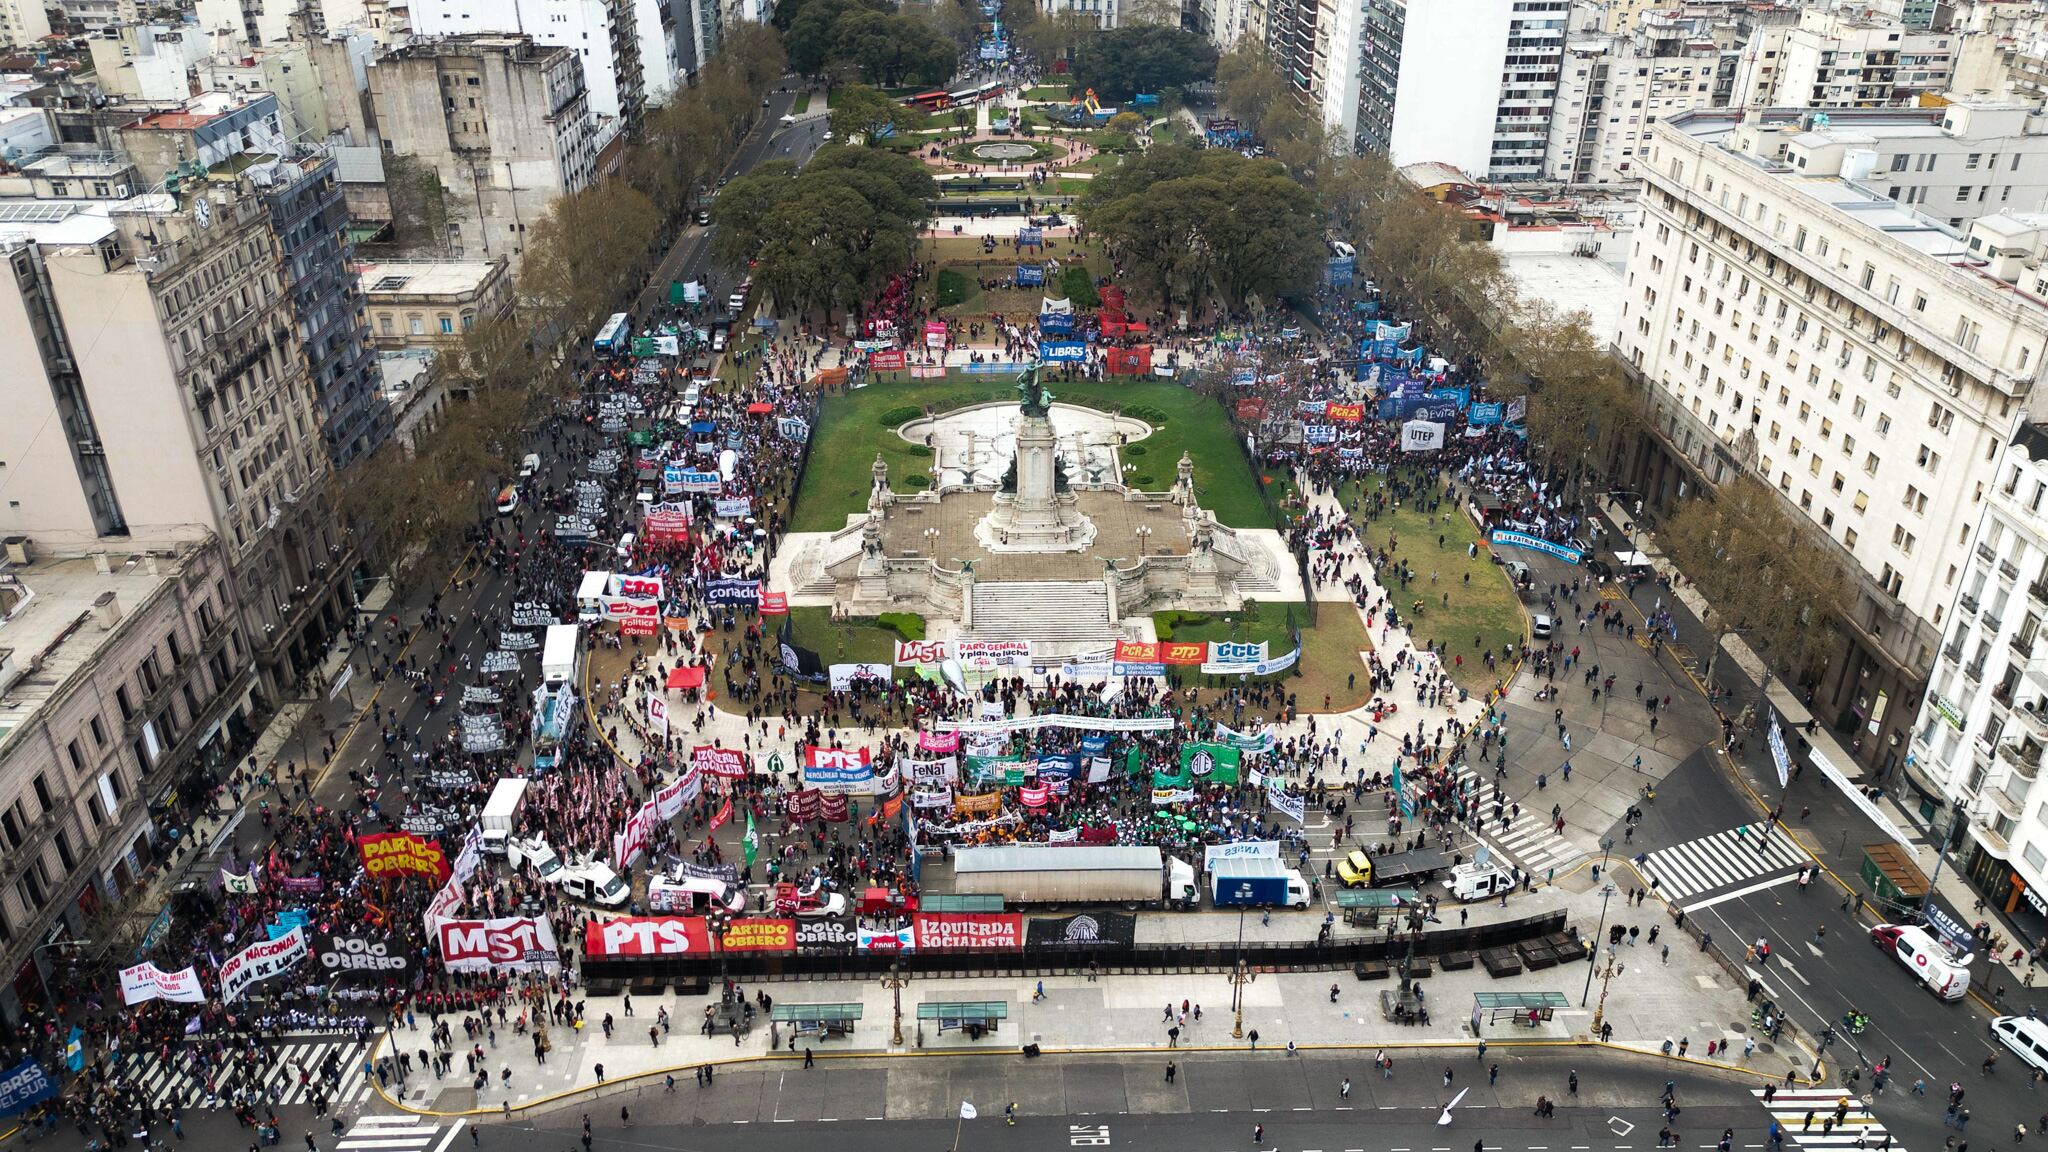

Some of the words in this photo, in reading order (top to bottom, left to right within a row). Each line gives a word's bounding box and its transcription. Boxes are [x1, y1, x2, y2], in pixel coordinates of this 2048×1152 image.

[1049, 346, 1084, 357] LIBRES
[1411, 430, 1434, 441] UTEP
[666, 473, 718, 483] SUTEBA
[559, 514, 591, 525] POLO
[709, 587, 760, 599] conadu
[514, 601, 550, 610] POLO
[501, 632, 533, 641] POLO
[624, 627, 653, 635] Obrera
[902, 641, 946, 662] MST
[959, 642, 986, 651] PARO
[987, 641, 1029, 651] GENERAL
[1121, 645, 1142, 656] PCR
[1216, 643, 1261, 657] CCC
[1170, 646, 1200, 659] PTP
[467, 733, 498, 743] POLO
[815, 750, 862, 771] PTS
[403, 817, 437, 825] POLO
[2023, 886, 2047, 917] PIZZA
[723, 924, 789, 936] ARTIDO
[801, 921, 845, 933] POLO
[921, 918, 1014, 937] IZQUIERDA
[448, 924, 535, 960] MST
[603, 922, 690, 955] PTS
[723, 936, 787, 948] OBRERO
[921, 935, 1015, 949] SOCIALISTA
[332, 936, 388, 957] POLO
[219, 957, 241, 983] PARO
[169, 971, 188, 982] MILEI
[229, 970, 252, 994] PLAN
[257, 961, 272, 977] DE
[20, 1078, 49, 1100] SUR
